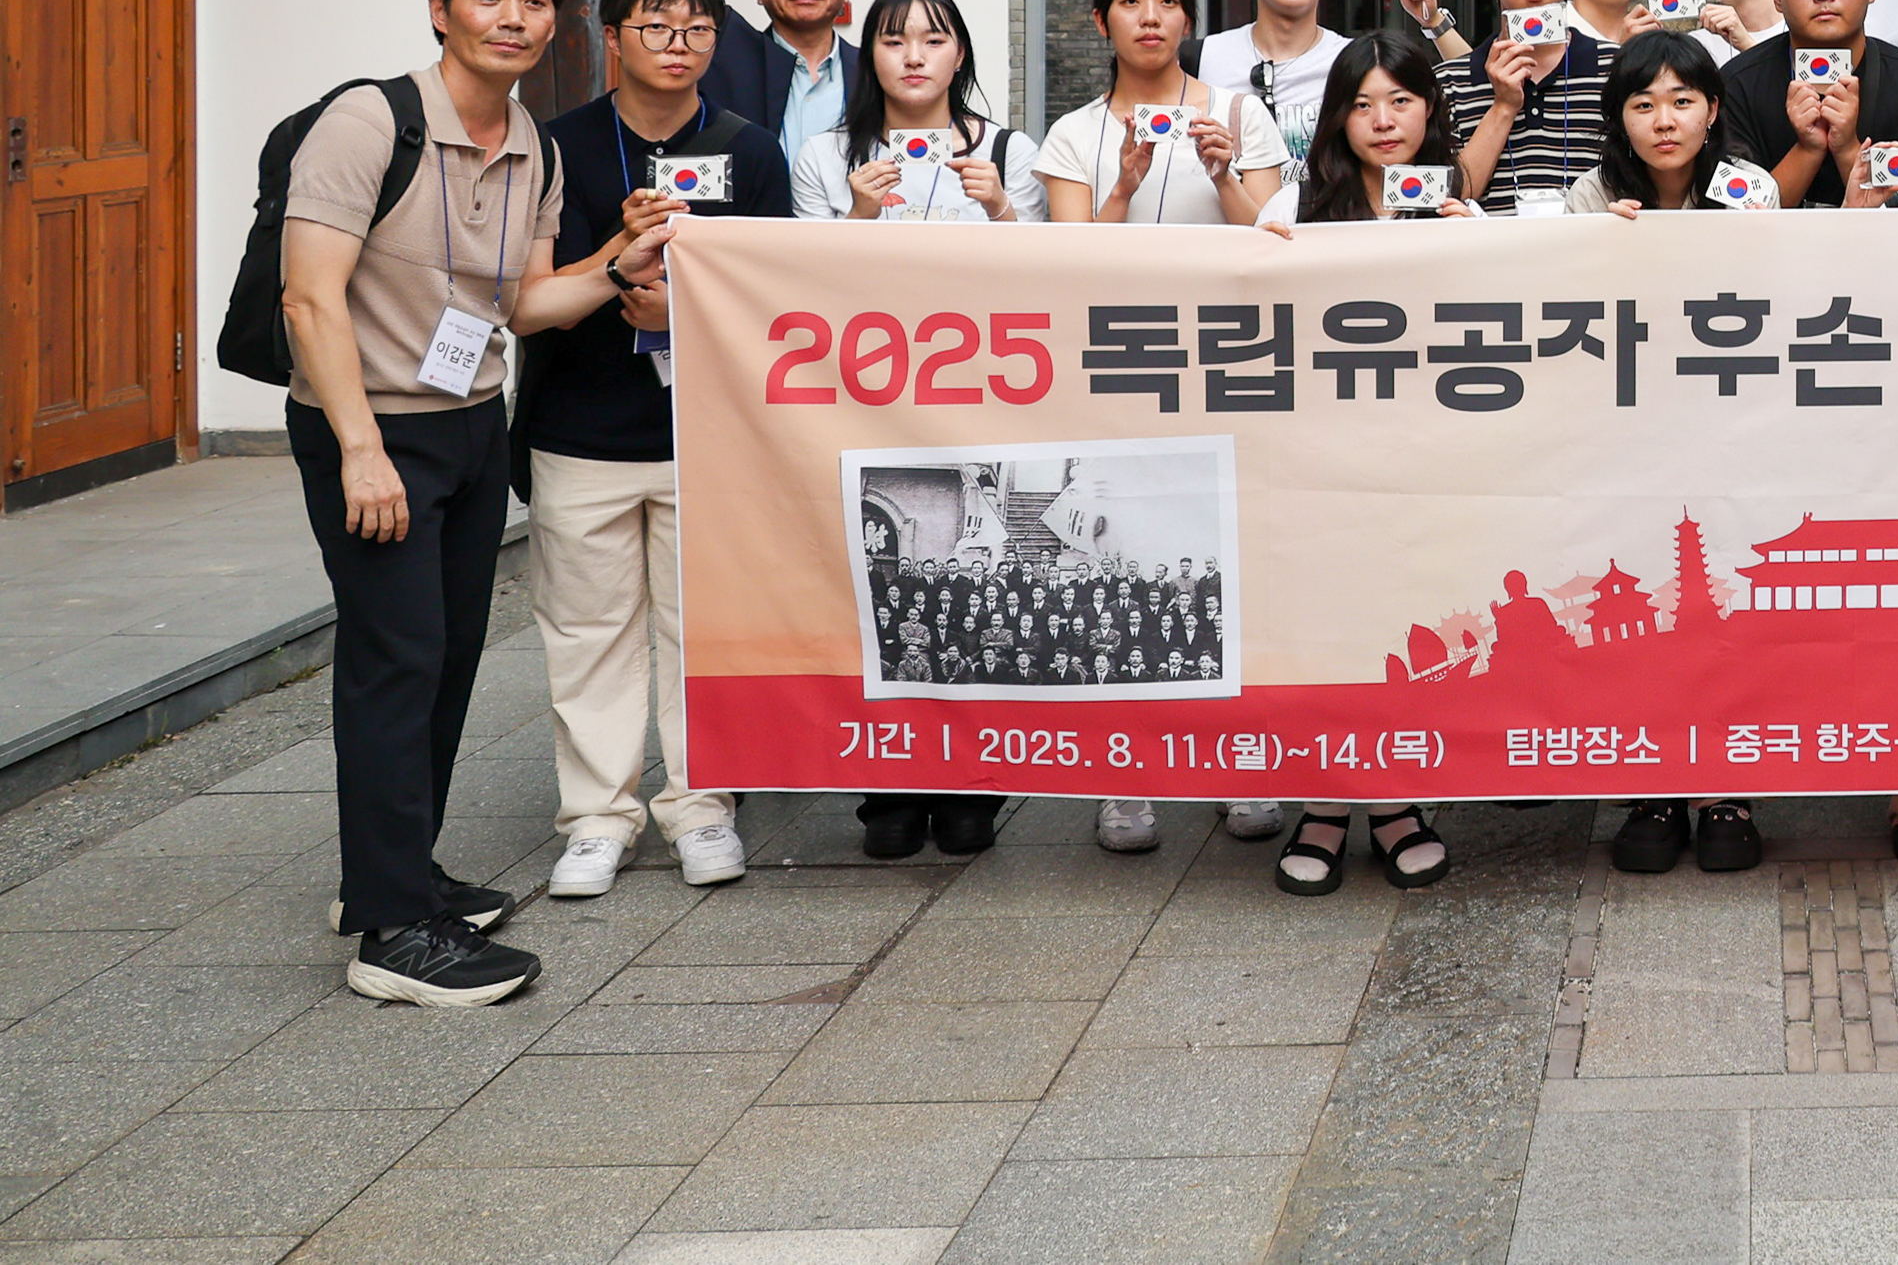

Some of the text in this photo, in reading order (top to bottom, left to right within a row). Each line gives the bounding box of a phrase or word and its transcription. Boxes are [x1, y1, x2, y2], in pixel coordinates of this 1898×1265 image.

[436, 341, 476, 369] 이갑준
[765, 311, 1054, 407] 2025
[1081, 299, 1649, 413] 독립유공자
[1676, 292, 1892, 407] 후손
[839, 722, 916, 759] 기간
[978, 728, 1092, 767] 2025.
[1107, 732, 1144, 769] 8.
[1506, 726, 1661, 766] 탐방장소
[1725, 724, 1802, 763] 중국
